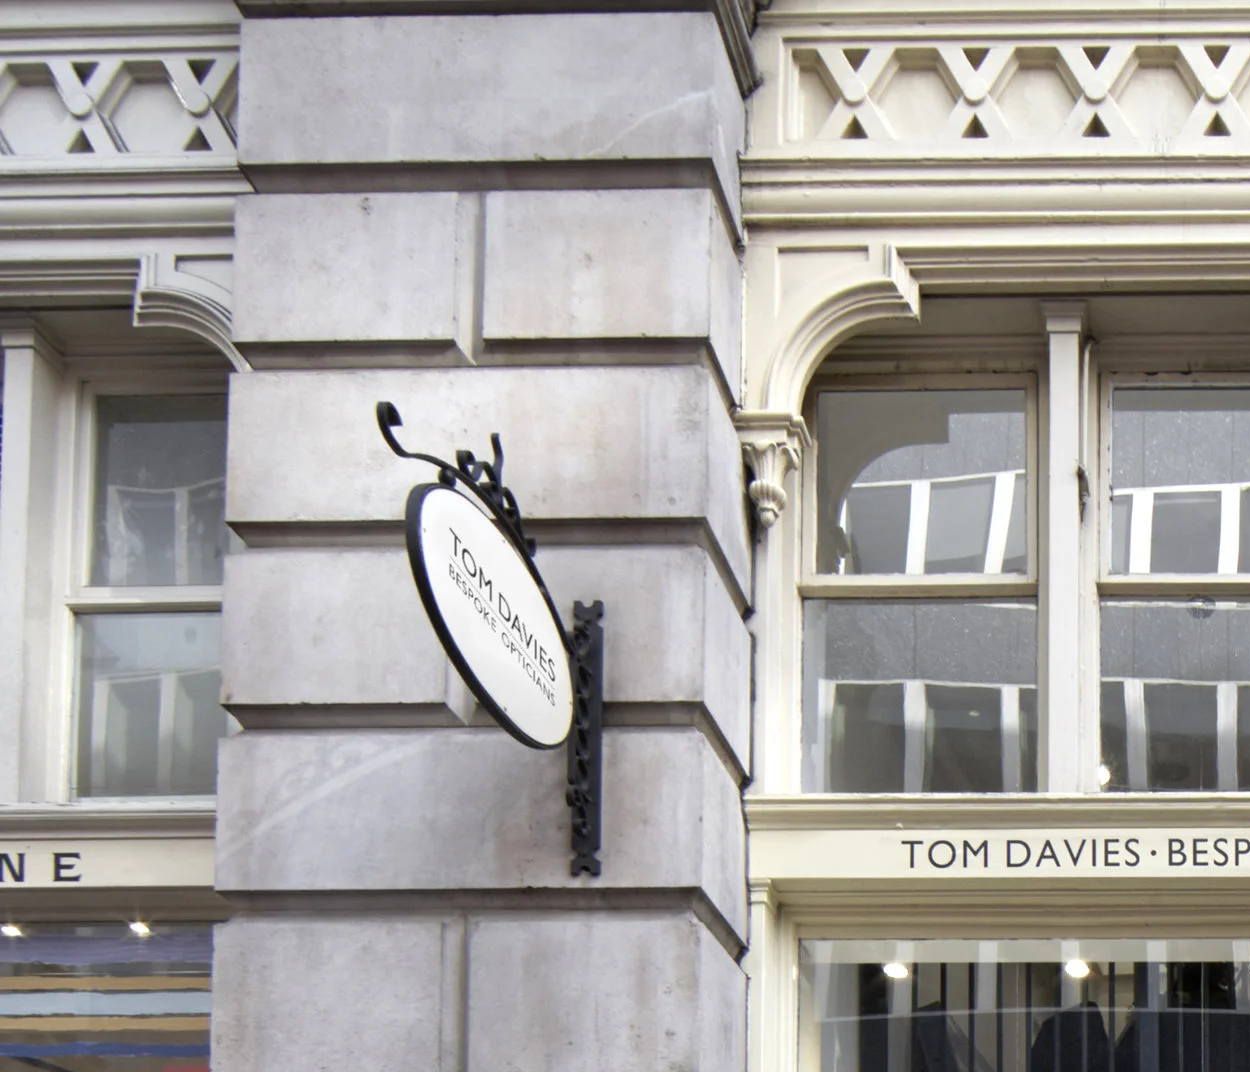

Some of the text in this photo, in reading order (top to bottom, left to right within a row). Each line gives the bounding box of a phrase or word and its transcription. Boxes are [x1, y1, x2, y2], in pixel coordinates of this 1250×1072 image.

[448, 564, 556, 707] BESPOKE OPTICIANS
[449, 527, 556, 683] TOM DAVIES
[901, 838, 988, 869] TOM
[1006, 838, 1140, 868] DAVIES
